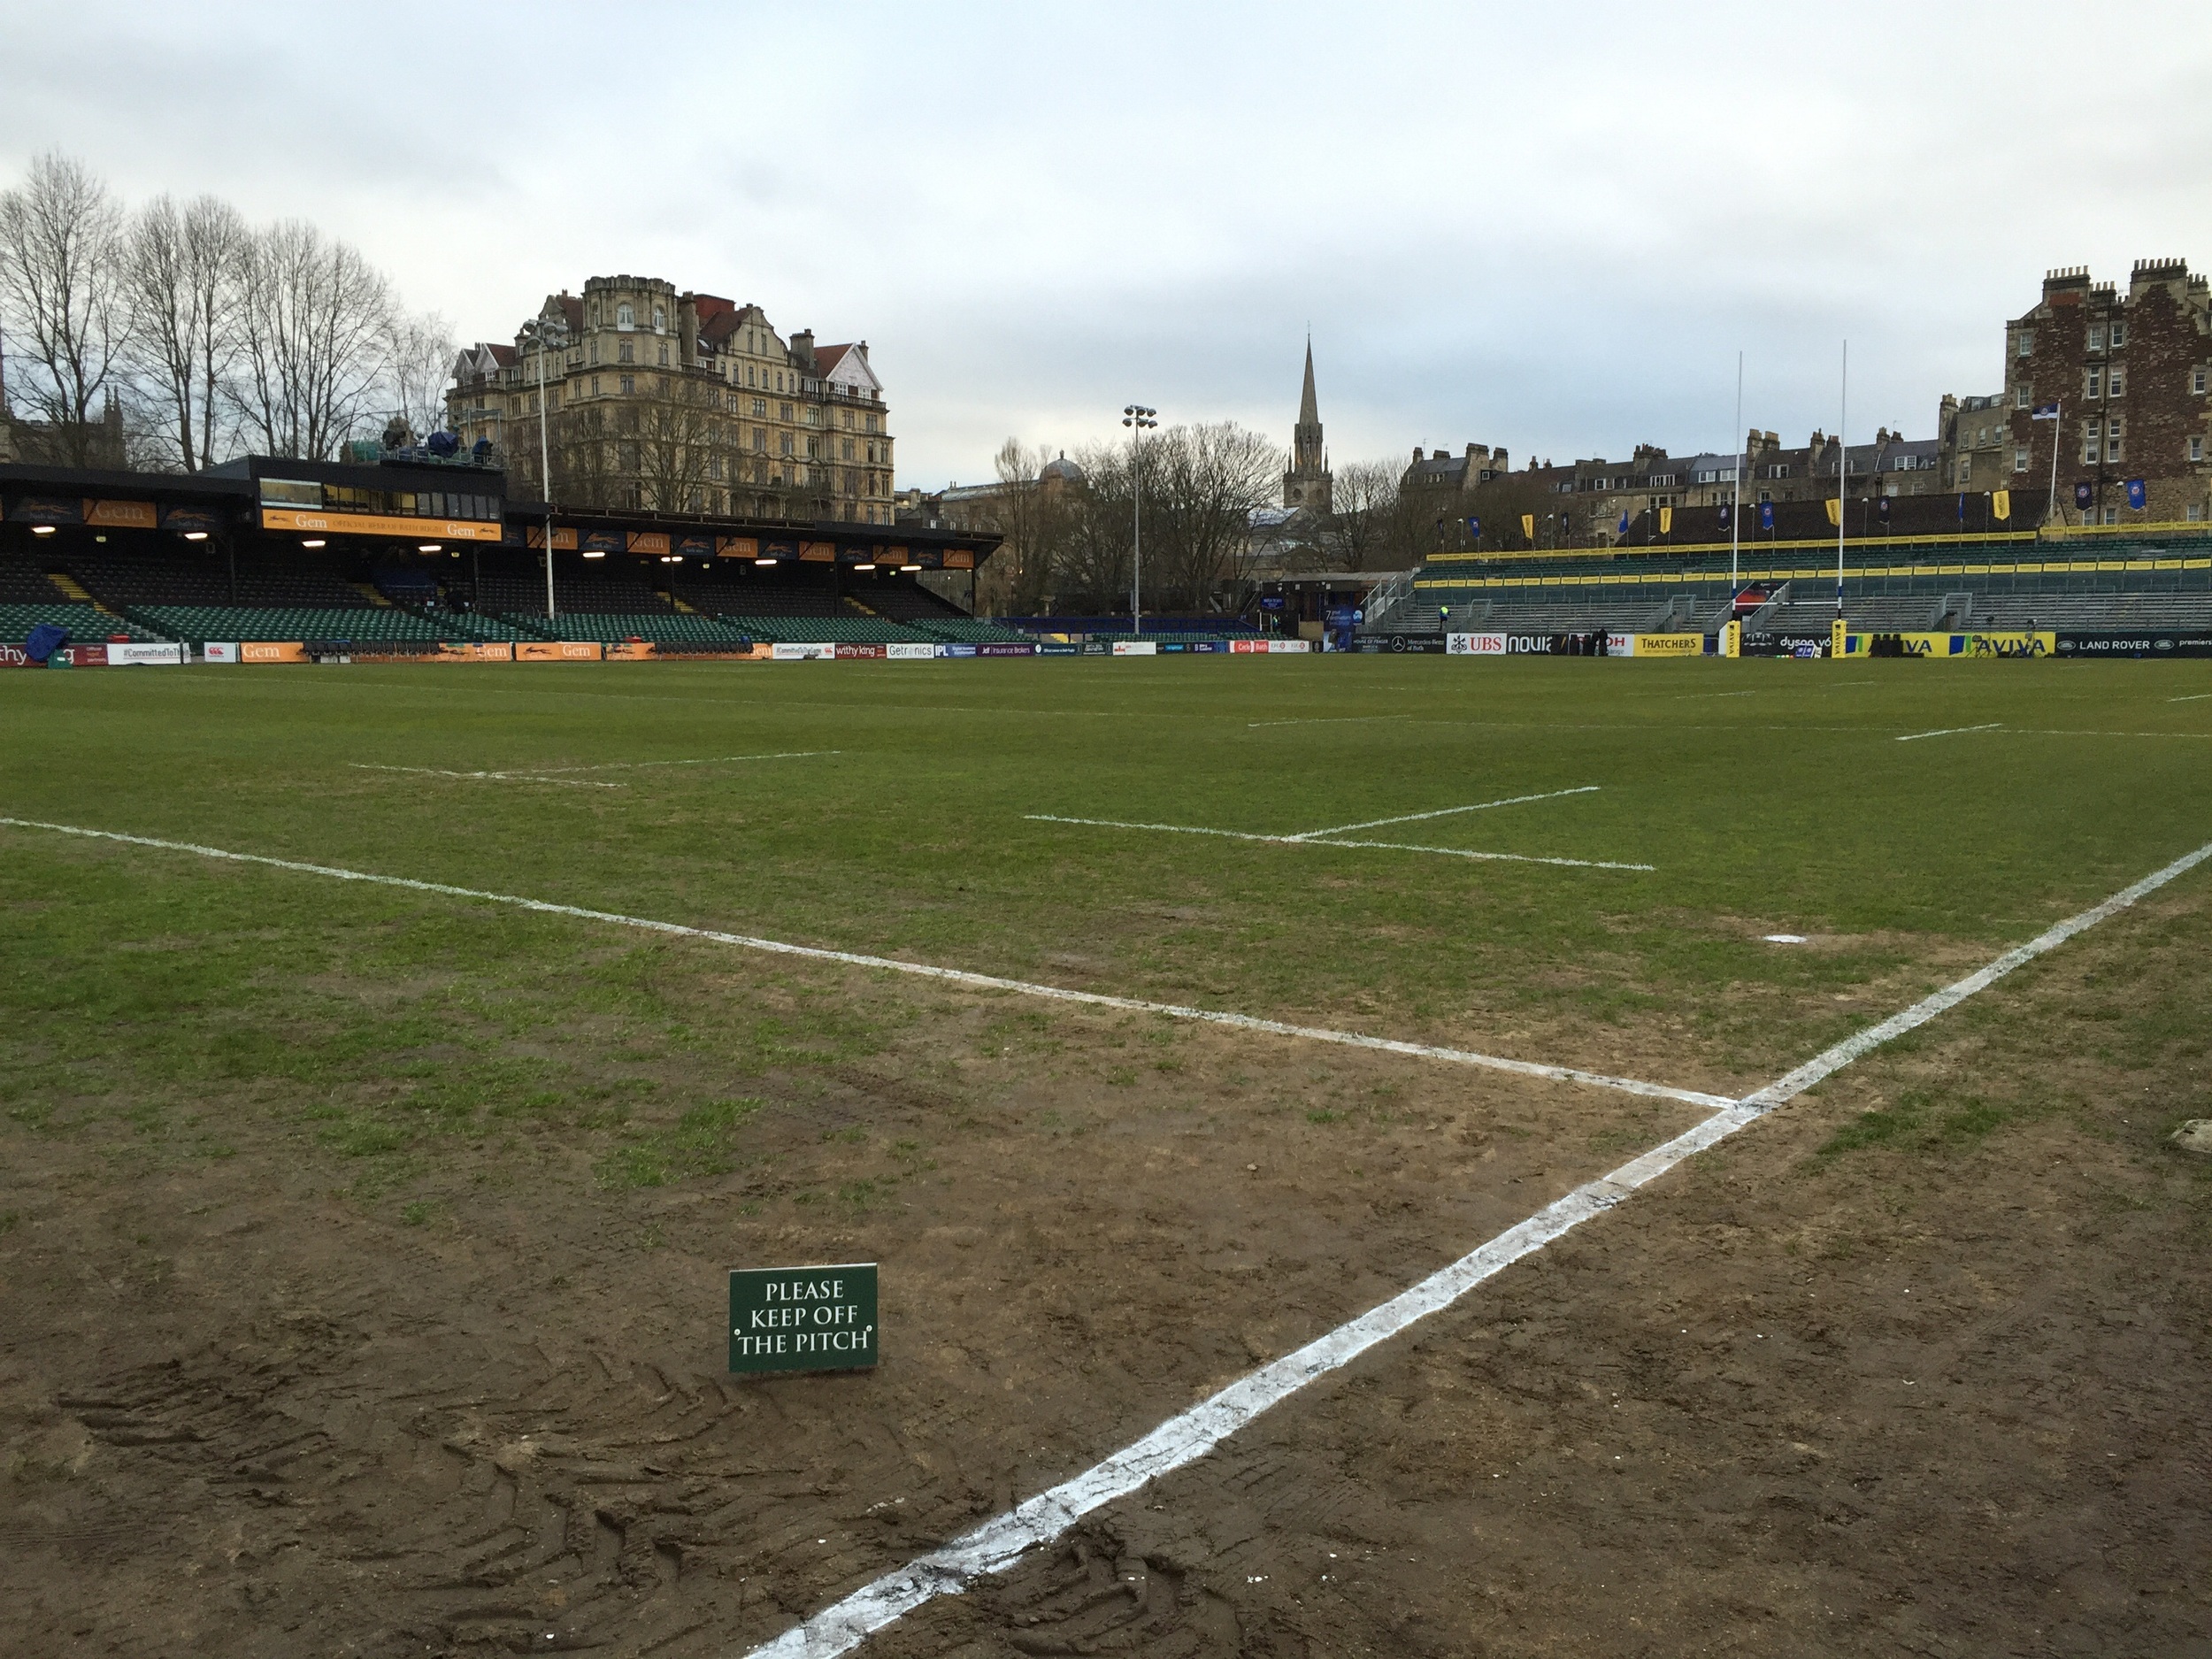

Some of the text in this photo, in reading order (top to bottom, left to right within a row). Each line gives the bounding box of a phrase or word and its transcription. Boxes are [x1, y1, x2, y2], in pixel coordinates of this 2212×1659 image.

[96, 502, 146, 520] Gem
[296, 514, 327, 528] Gem
[448, 524, 476, 537] Gem
[1256, 642, 1268, 651] Bath
[1470, 636, 1502, 651] UBS
[1641, 638, 1696, 649] THATCHERS
[1978, 639, 2046, 653] AVIVA
[2079, 641, 2109, 649] LAND
[2112, 641, 2150, 649] ROVER
[242, 644, 280, 657] Gem
[563, 644, 591, 657] Gem
[836, 645, 858, 657] withy
[859, 645, 875, 657] king
[934, 645, 949, 657] IPL
[993, 646, 1013, 655] Insurance
[1014, 646, 1030, 655] Brokers
[765, 1279, 844, 1302] PLEASE
[751, 1305, 858, 1329] KEEP OFF
[737, 1331, 869, 1356] THE PITCH
